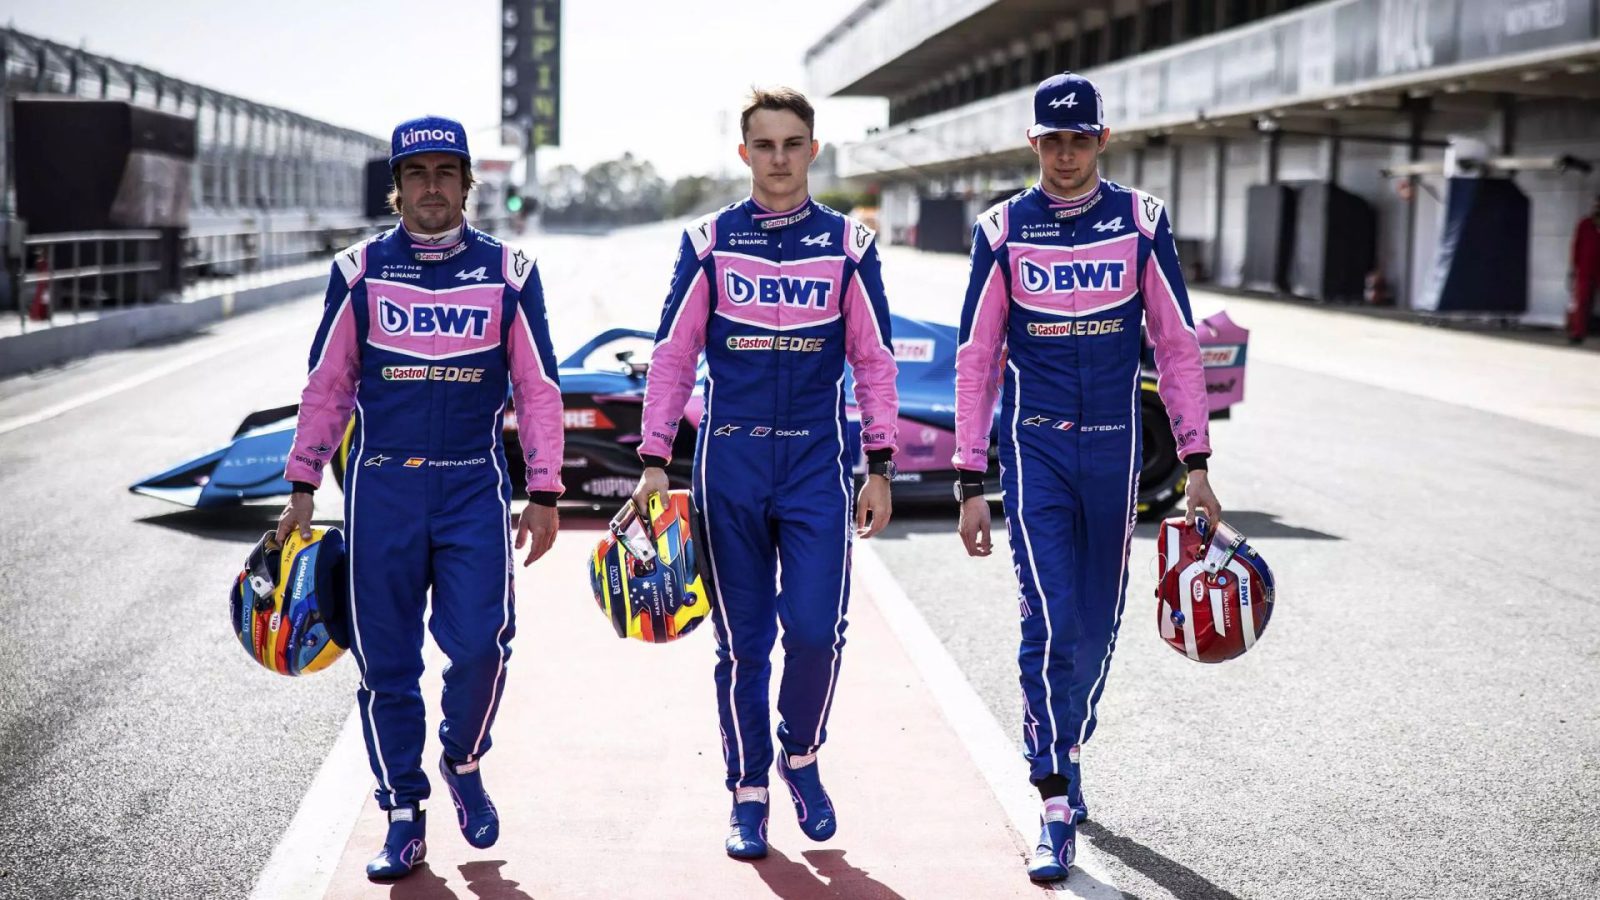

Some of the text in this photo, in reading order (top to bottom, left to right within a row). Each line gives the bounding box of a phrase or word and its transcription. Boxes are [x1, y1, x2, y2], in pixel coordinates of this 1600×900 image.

[401, 128, 456, 148] kimoa
[767, 219, 788, 229] Castrol
[789, 206, 812, 224] EDGE
[421, 242, 468, 261] Castrol EDGE
[1053, 262, 1125, 292] BWT
[758, 276, 832, 308] BWT
[412, 305, 490, 338] BWT
[1037, 318, 1124, 336] Castrol EDGE
[739, 337, 826, 352] Castrol EDGE
[393, 366, 486, 383] Castrol EDGE
[775, 429, 810, 437] OSCAR
[1080, 424, 1126, 432] ESTEBAN
[428, 457, 487, 467] FERNANDO
[292, 555, 310, 600] finetwork
[651, 582, 661, 616] MANDIANT
[1240, 584, 1249, 607] BWT
[1223, 591, 1231, 628] MANDIANT
[271, 614, 279, 631] BELL
